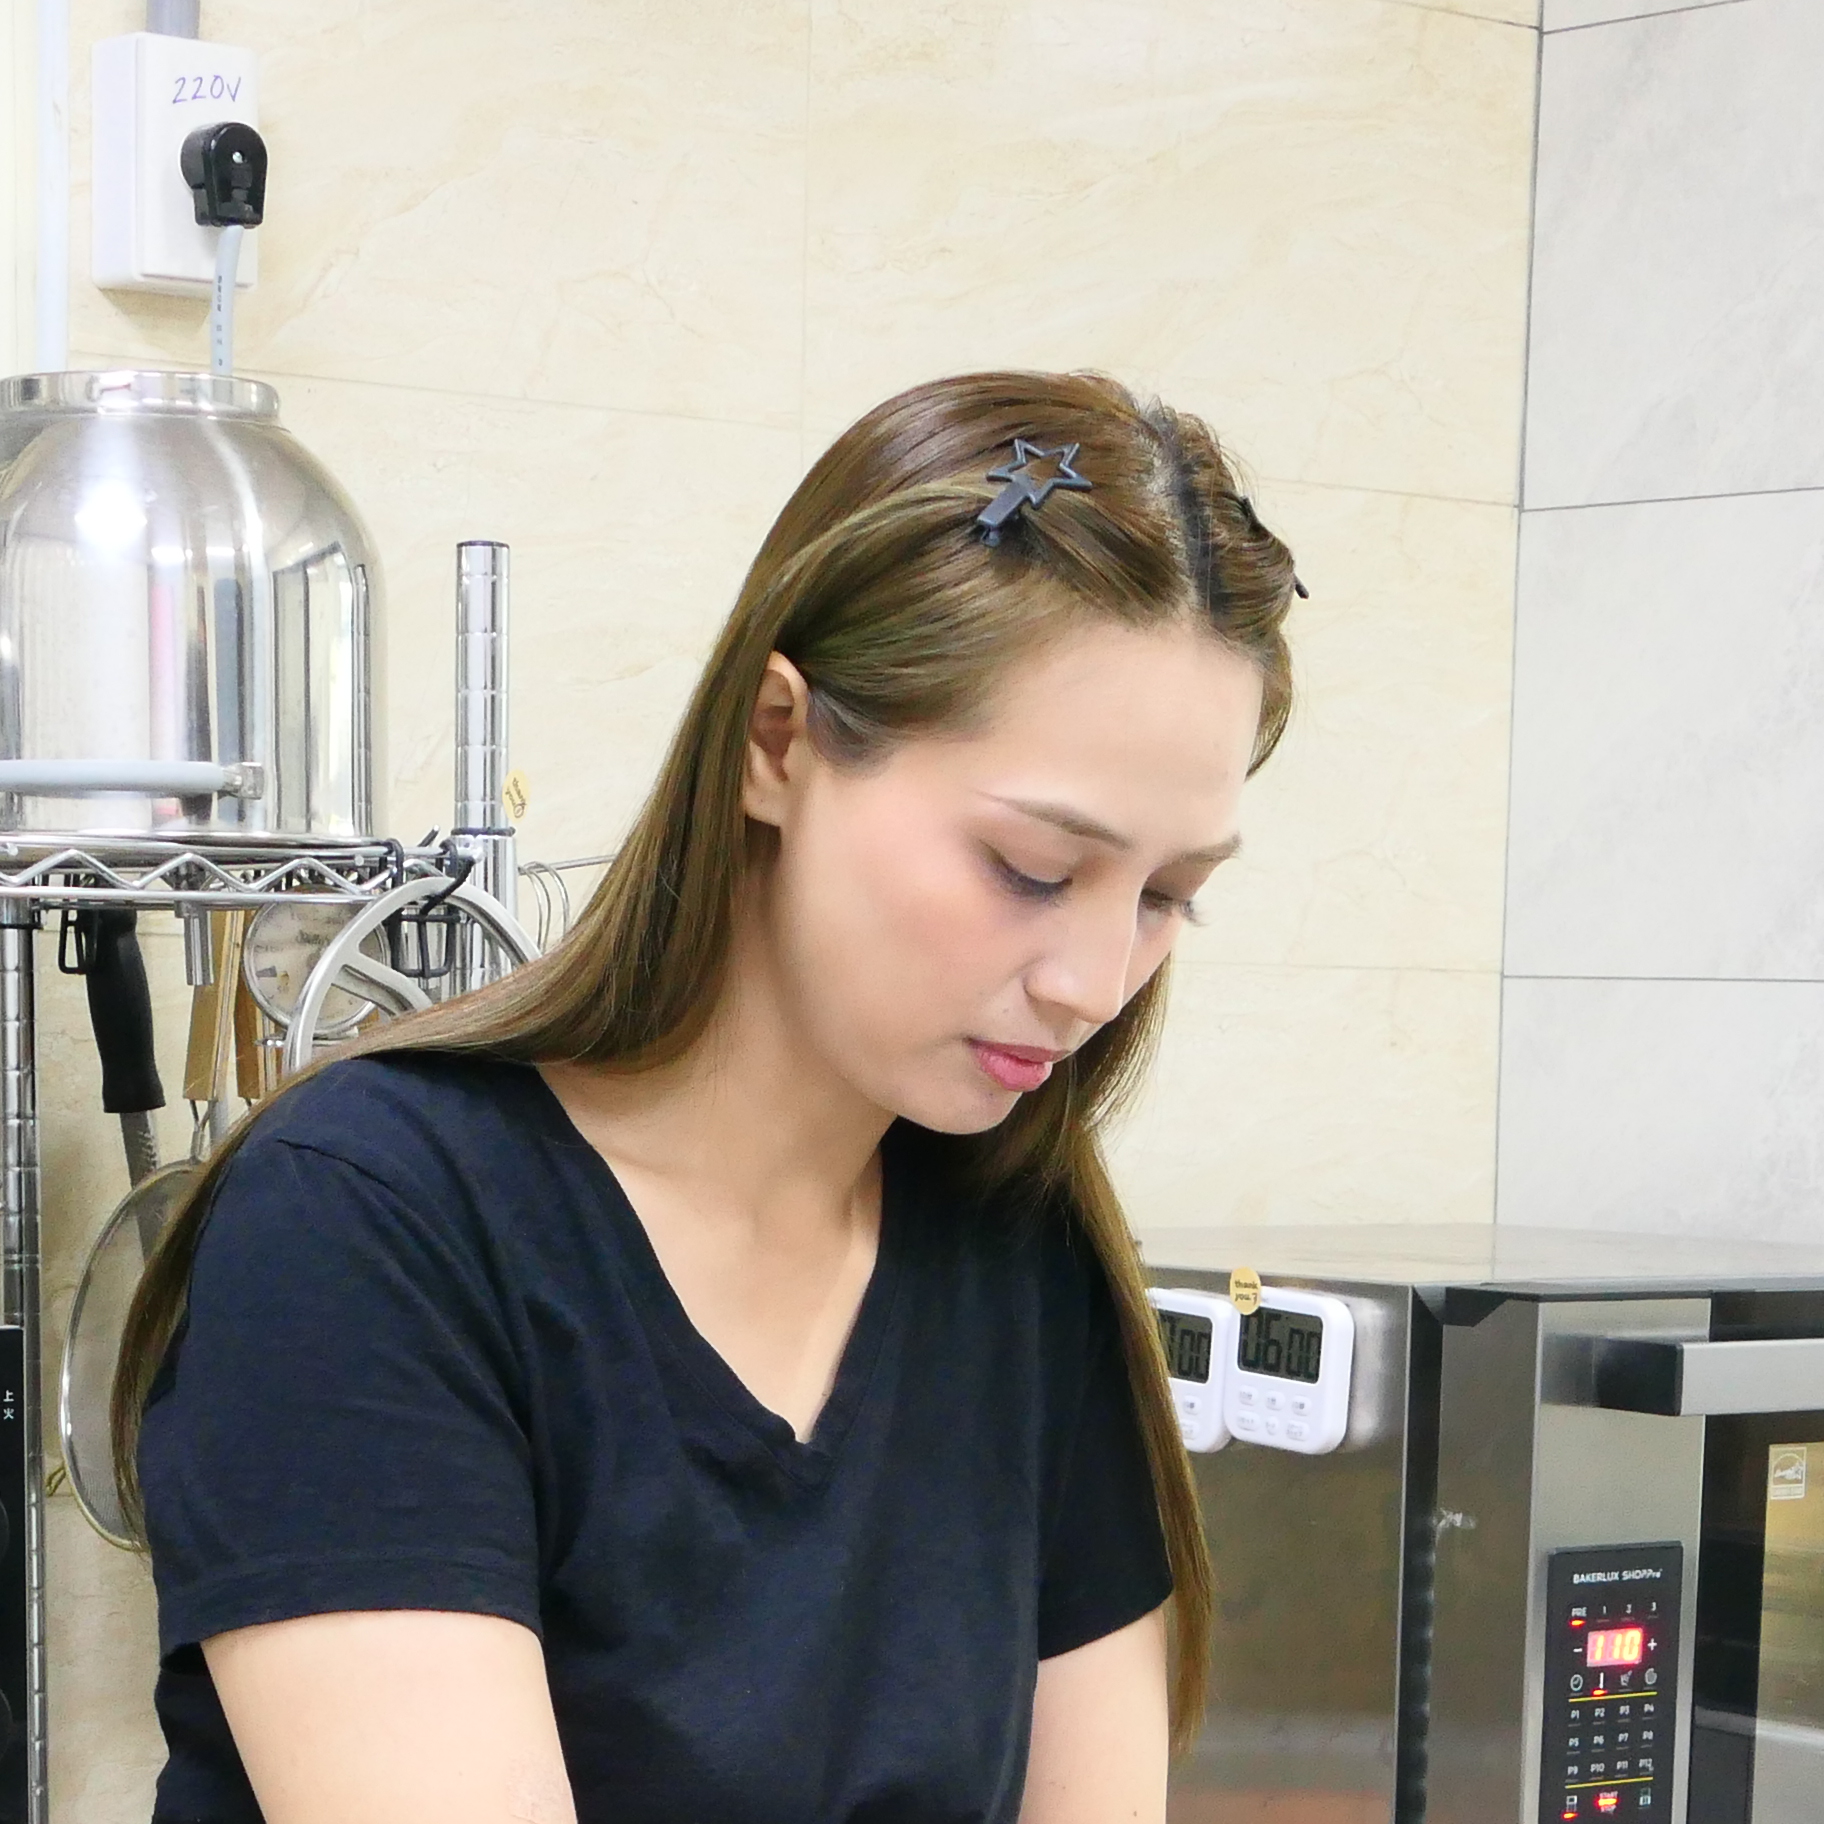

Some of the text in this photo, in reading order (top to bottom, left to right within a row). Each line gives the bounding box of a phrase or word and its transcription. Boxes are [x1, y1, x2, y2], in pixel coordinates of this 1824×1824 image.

[172, 75, 241, 104] 220V
[1573, 1571, 1619, 1585] BAKERLUX
[1595, 1630, 1642, 1662] 110
